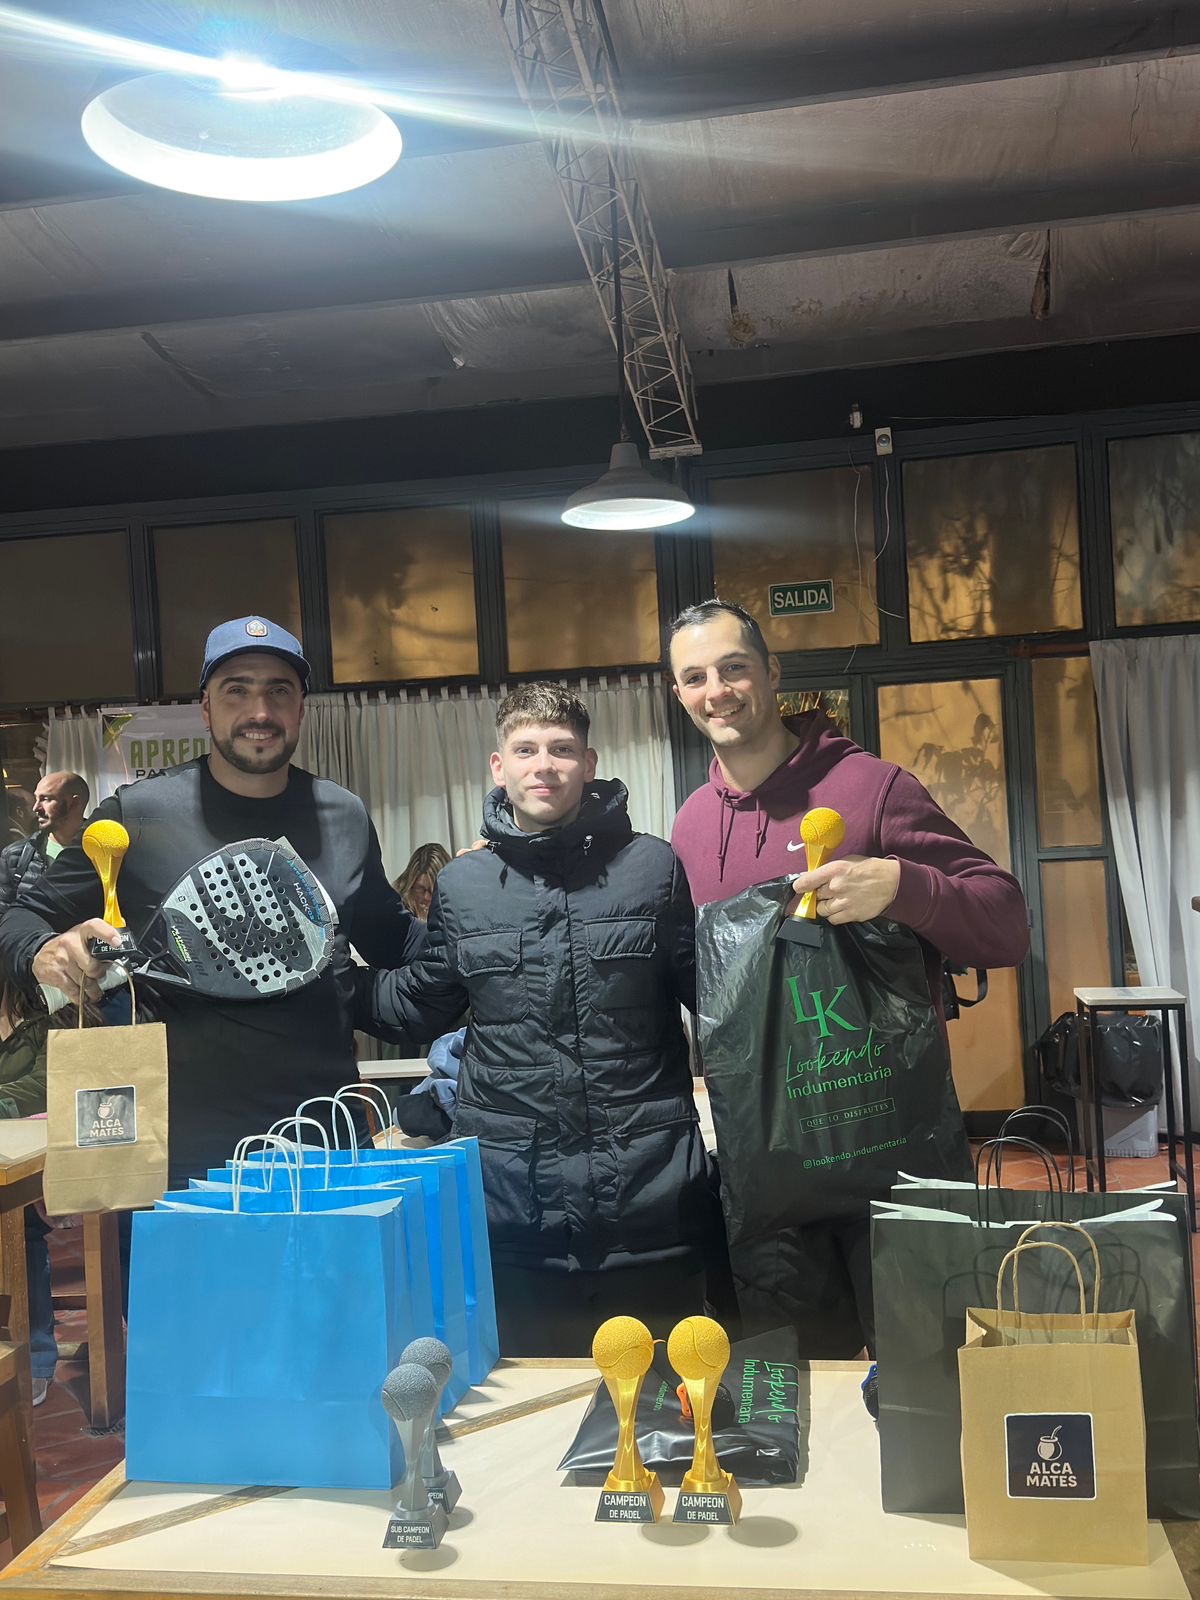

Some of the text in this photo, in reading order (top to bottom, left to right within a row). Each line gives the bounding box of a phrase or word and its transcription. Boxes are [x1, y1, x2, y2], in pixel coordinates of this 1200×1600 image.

[774, 588, 829, 608] SALIDA
[786, 1027, 886, 1082] Lookendo
[787, 1066, 892, 1099] Indumentaria
[806, 1103, 889, 1128] QUE LO DISFRUTES
[92, 1119, 122, 1129] ALCA
[89, 1127, 124, 1137] MATES
[803, 1137, 907, 1169] @lookendo.indumentaria
[738, 1359, 760, 1424] Indumentaria
[1030, 1462, 1073, 1474] ALCA
[1026, 1475, 1078, 1487] MATES
[604, 1494, 646, 1507] CAMPEON
[681, 1496, 724, 1508] CAMPEON
[609, 1509, 641, 1519] DE PADEL
[687, 1511, 719, 1521] DE PADEL
[390, 1525, 430, 1534] SUB CAMPEON
[397, 1535, 423, 1543] DE PADEL
